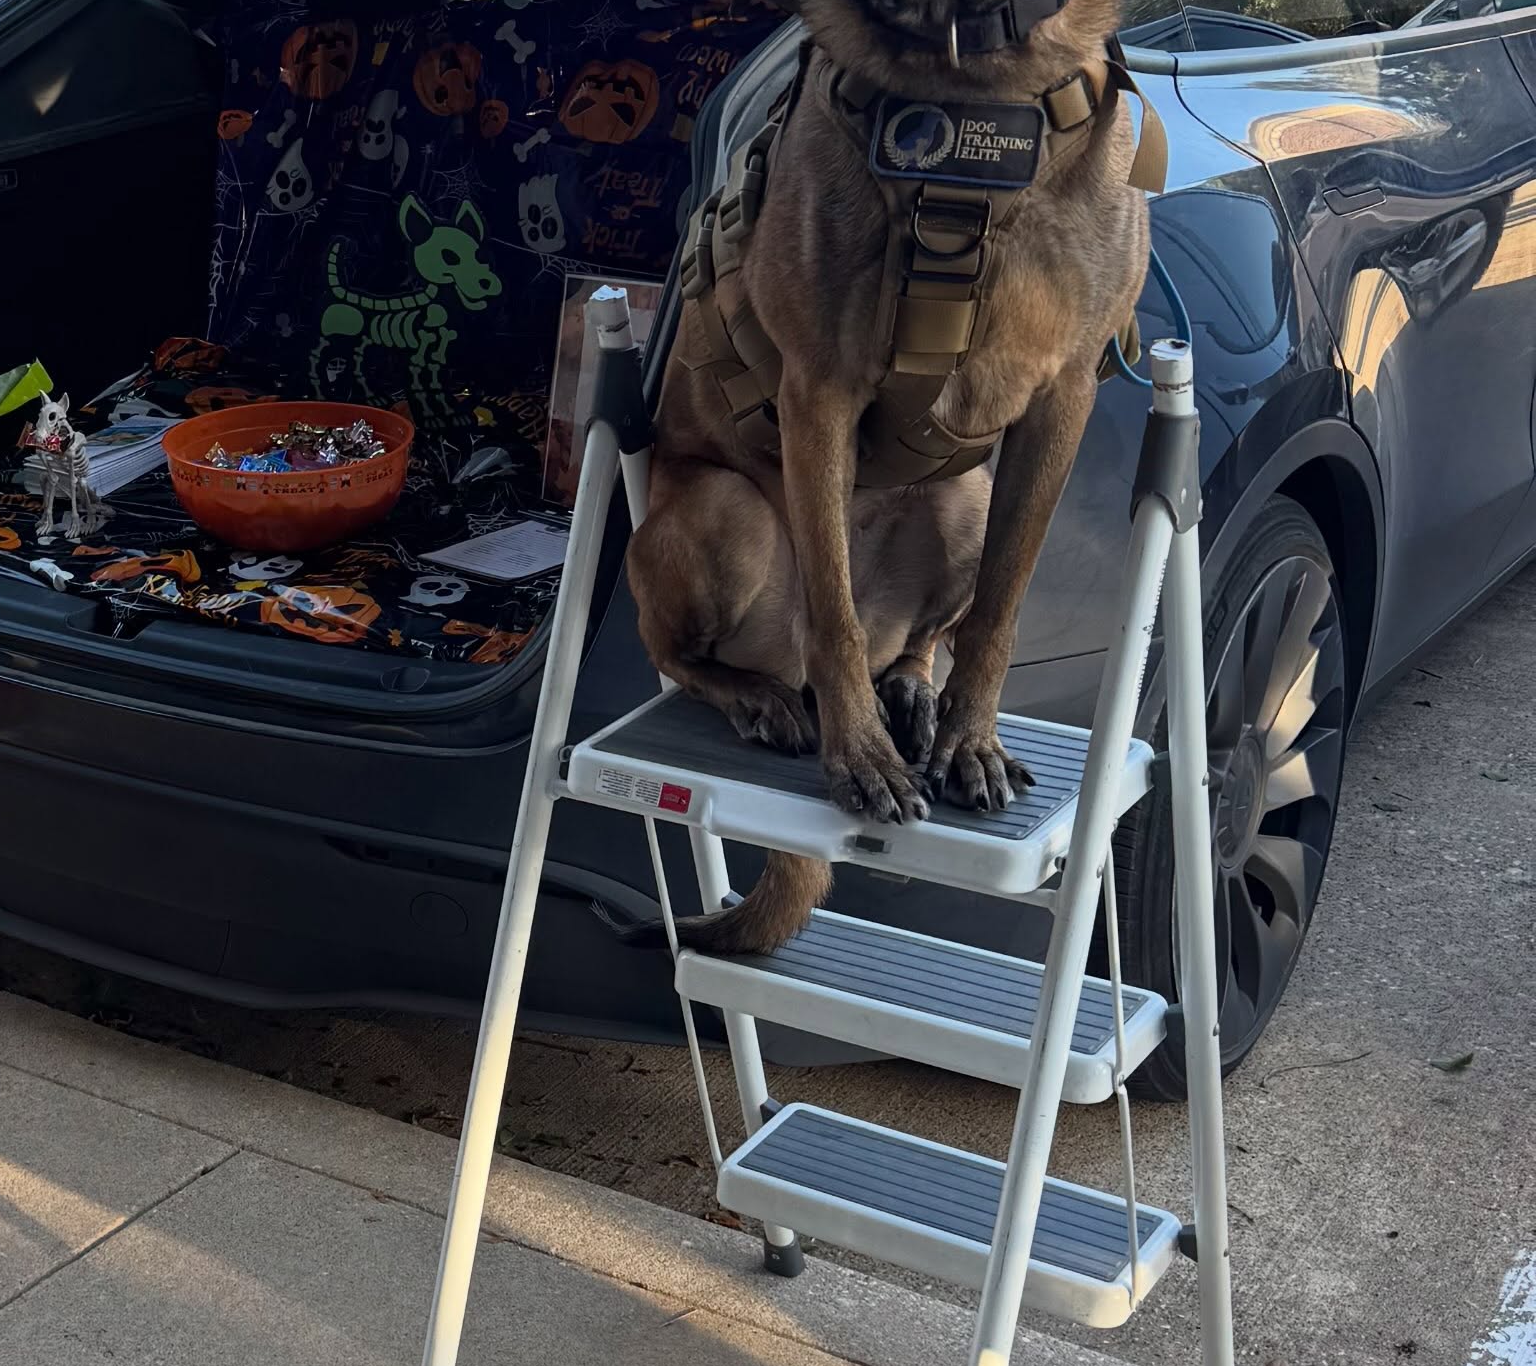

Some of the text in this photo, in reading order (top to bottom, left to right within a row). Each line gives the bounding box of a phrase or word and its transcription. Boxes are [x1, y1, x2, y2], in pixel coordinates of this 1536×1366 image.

[966, 121, 996, 134] DOG
[964, 134, 1033, 150] TRAINING
[960, 147, 1001, 161] ELITE
